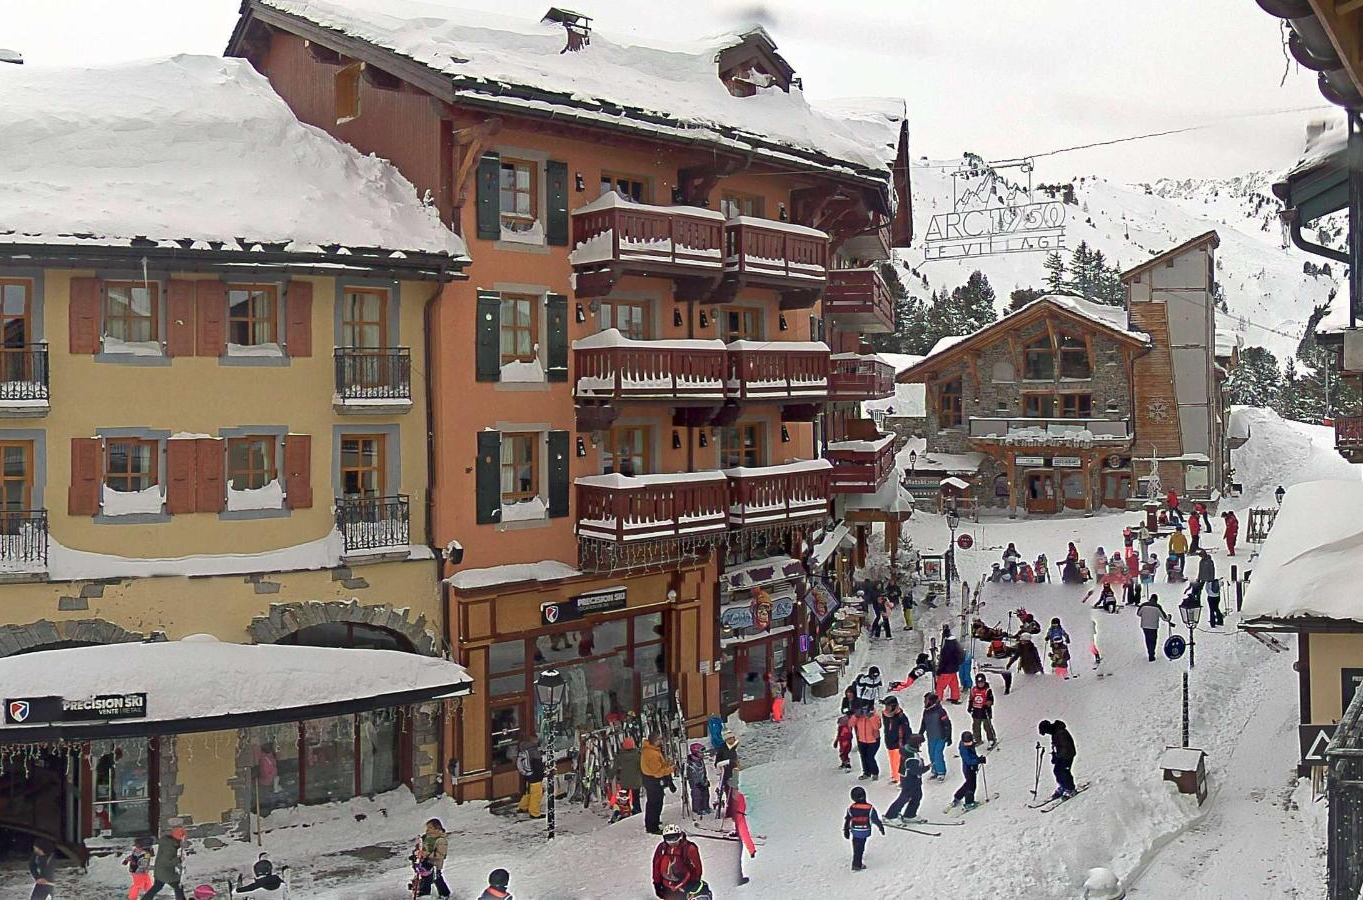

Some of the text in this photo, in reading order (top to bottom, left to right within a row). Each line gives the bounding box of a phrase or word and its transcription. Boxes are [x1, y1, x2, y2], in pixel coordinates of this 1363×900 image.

[925, 201, 1066, 241] ARC 1950
[63, 696, 144, 711] PRECISION SKI
